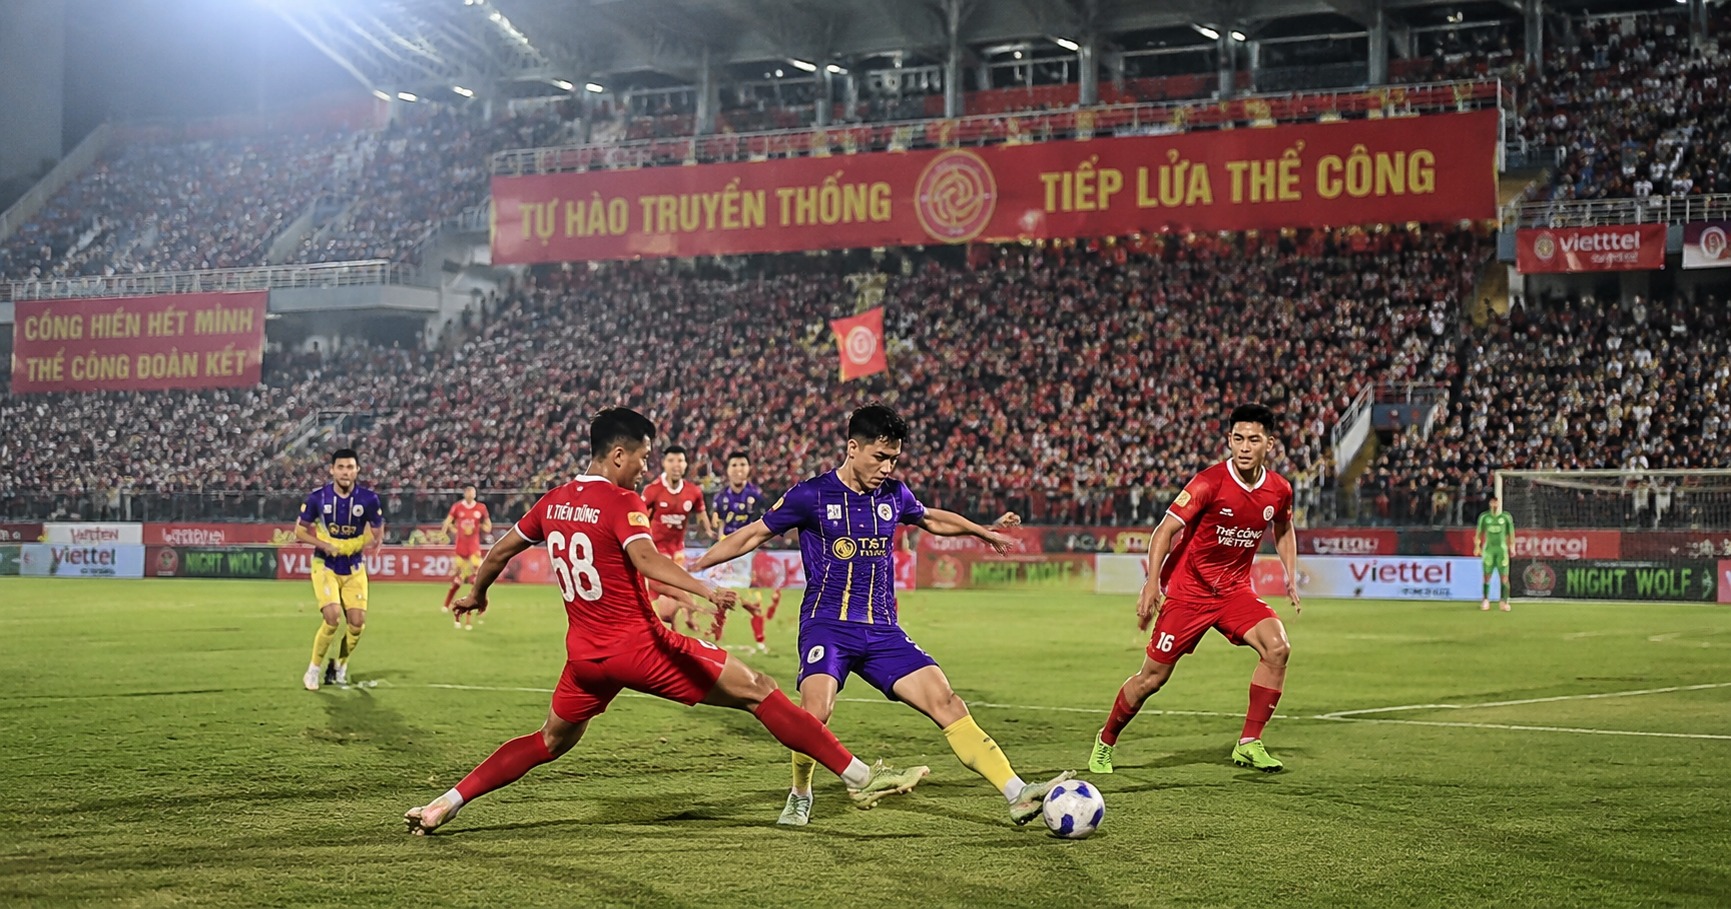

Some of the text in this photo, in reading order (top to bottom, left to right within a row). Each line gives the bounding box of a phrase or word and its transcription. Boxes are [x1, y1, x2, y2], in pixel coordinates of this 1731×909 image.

[1137, 149, 1213, 208] LỬA
[1225, 139, 1306, 203] THỂ
[1317, 143, 1435, 199] CÔNG
[518, 198, 558, 246] TỰ
[565, 190, 629, 237] HÀO
[775, 169, 892, 226] THỐNG
[547, 530, 603, 603] 68
[1349, 560, 1452, 583] Viettel
[1566, 568, 1692, 596] NIGHT WOLF
[1156, 631, 1175, 652] 16
